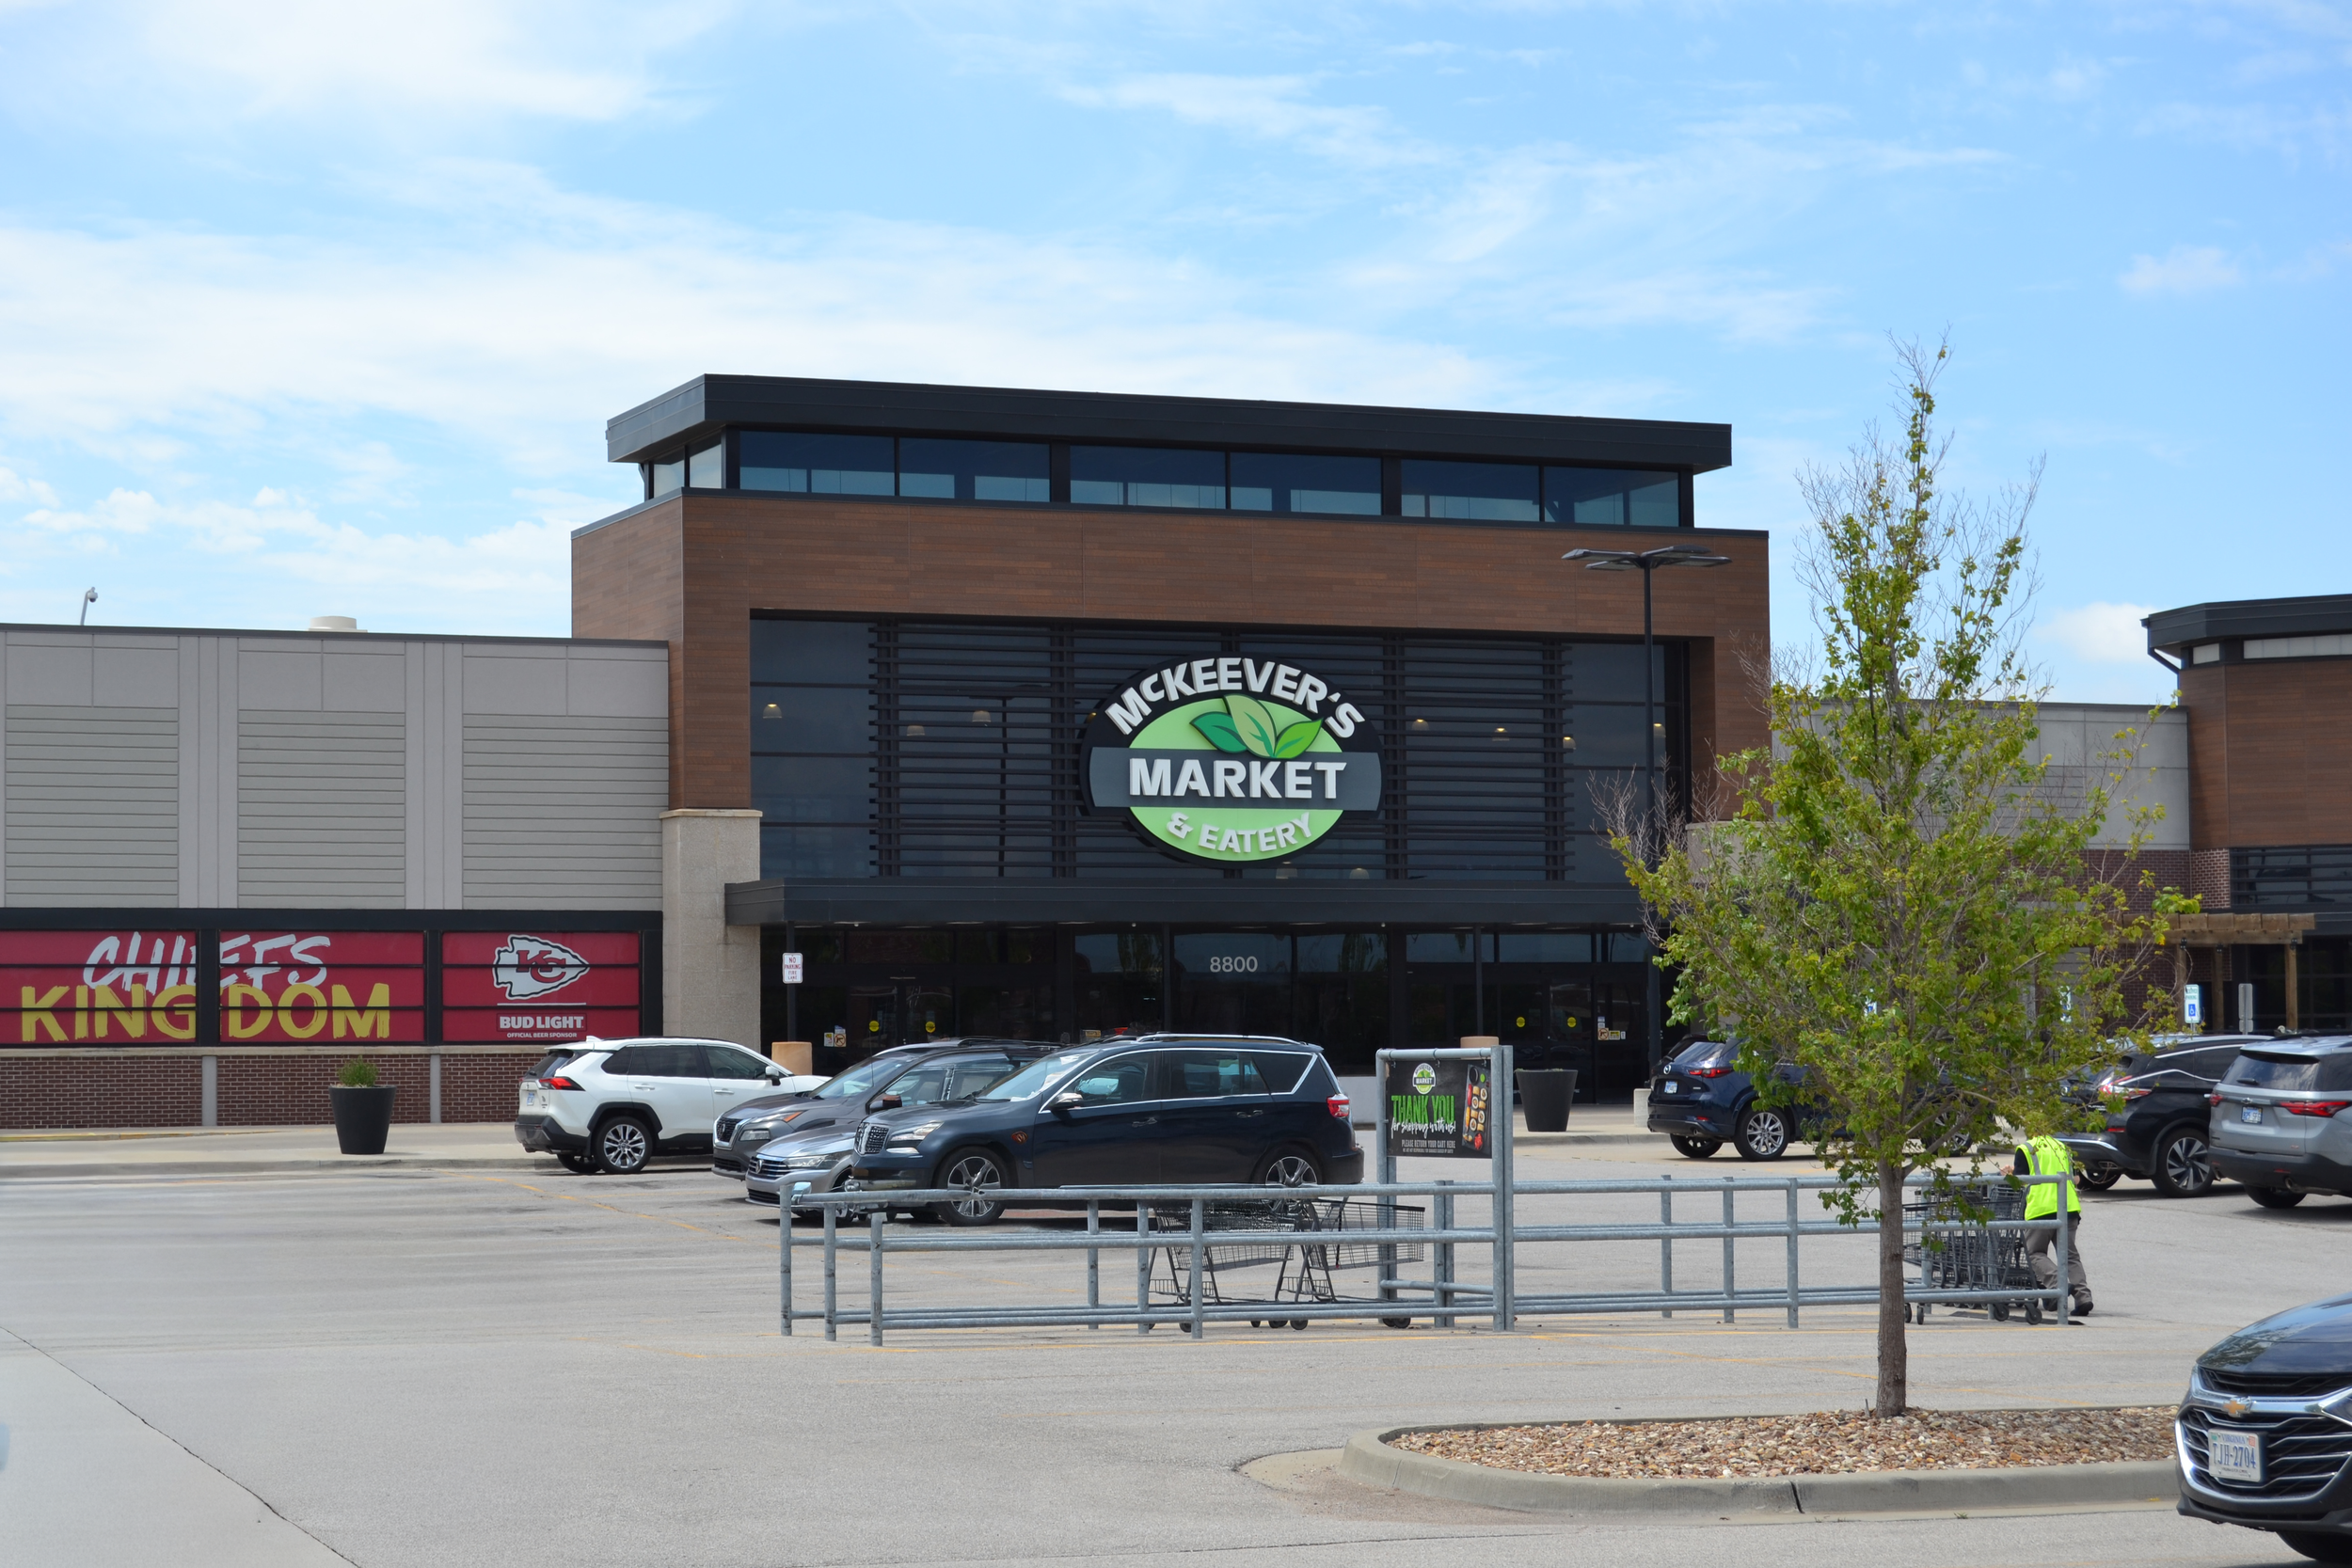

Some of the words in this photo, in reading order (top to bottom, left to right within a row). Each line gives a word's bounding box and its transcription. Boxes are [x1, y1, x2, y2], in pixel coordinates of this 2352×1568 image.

[1129, 757, 1347, 799] MARKET
[1166, 812, 1194, 839] &
[1198, 812, 1313, 853] EATERY
[83, 931, 331, 995] CHIEFS
[1210, 956, 1258, 973] 8800
[21, 983, 389, 1042] KINGDOM
[500, 1016, 534, 1029] BUD
[536, 1016, 583, 1029] LIGHT
[1391, 1095, 1429, 1125] THANK
[1431, 1095, 1454, 1125] YOU
[1391, 1117, 1401, 1139] for
[1401, 1118, 1429, 1139] shopping
[1429, 1117, 1445, 1132] with
[1445, 1120, 1456, 1134] us!
[2222, 1433, 2246, 1444] VIRGINIA
[2213, 1442, 2256, 1469] TJH-2704
